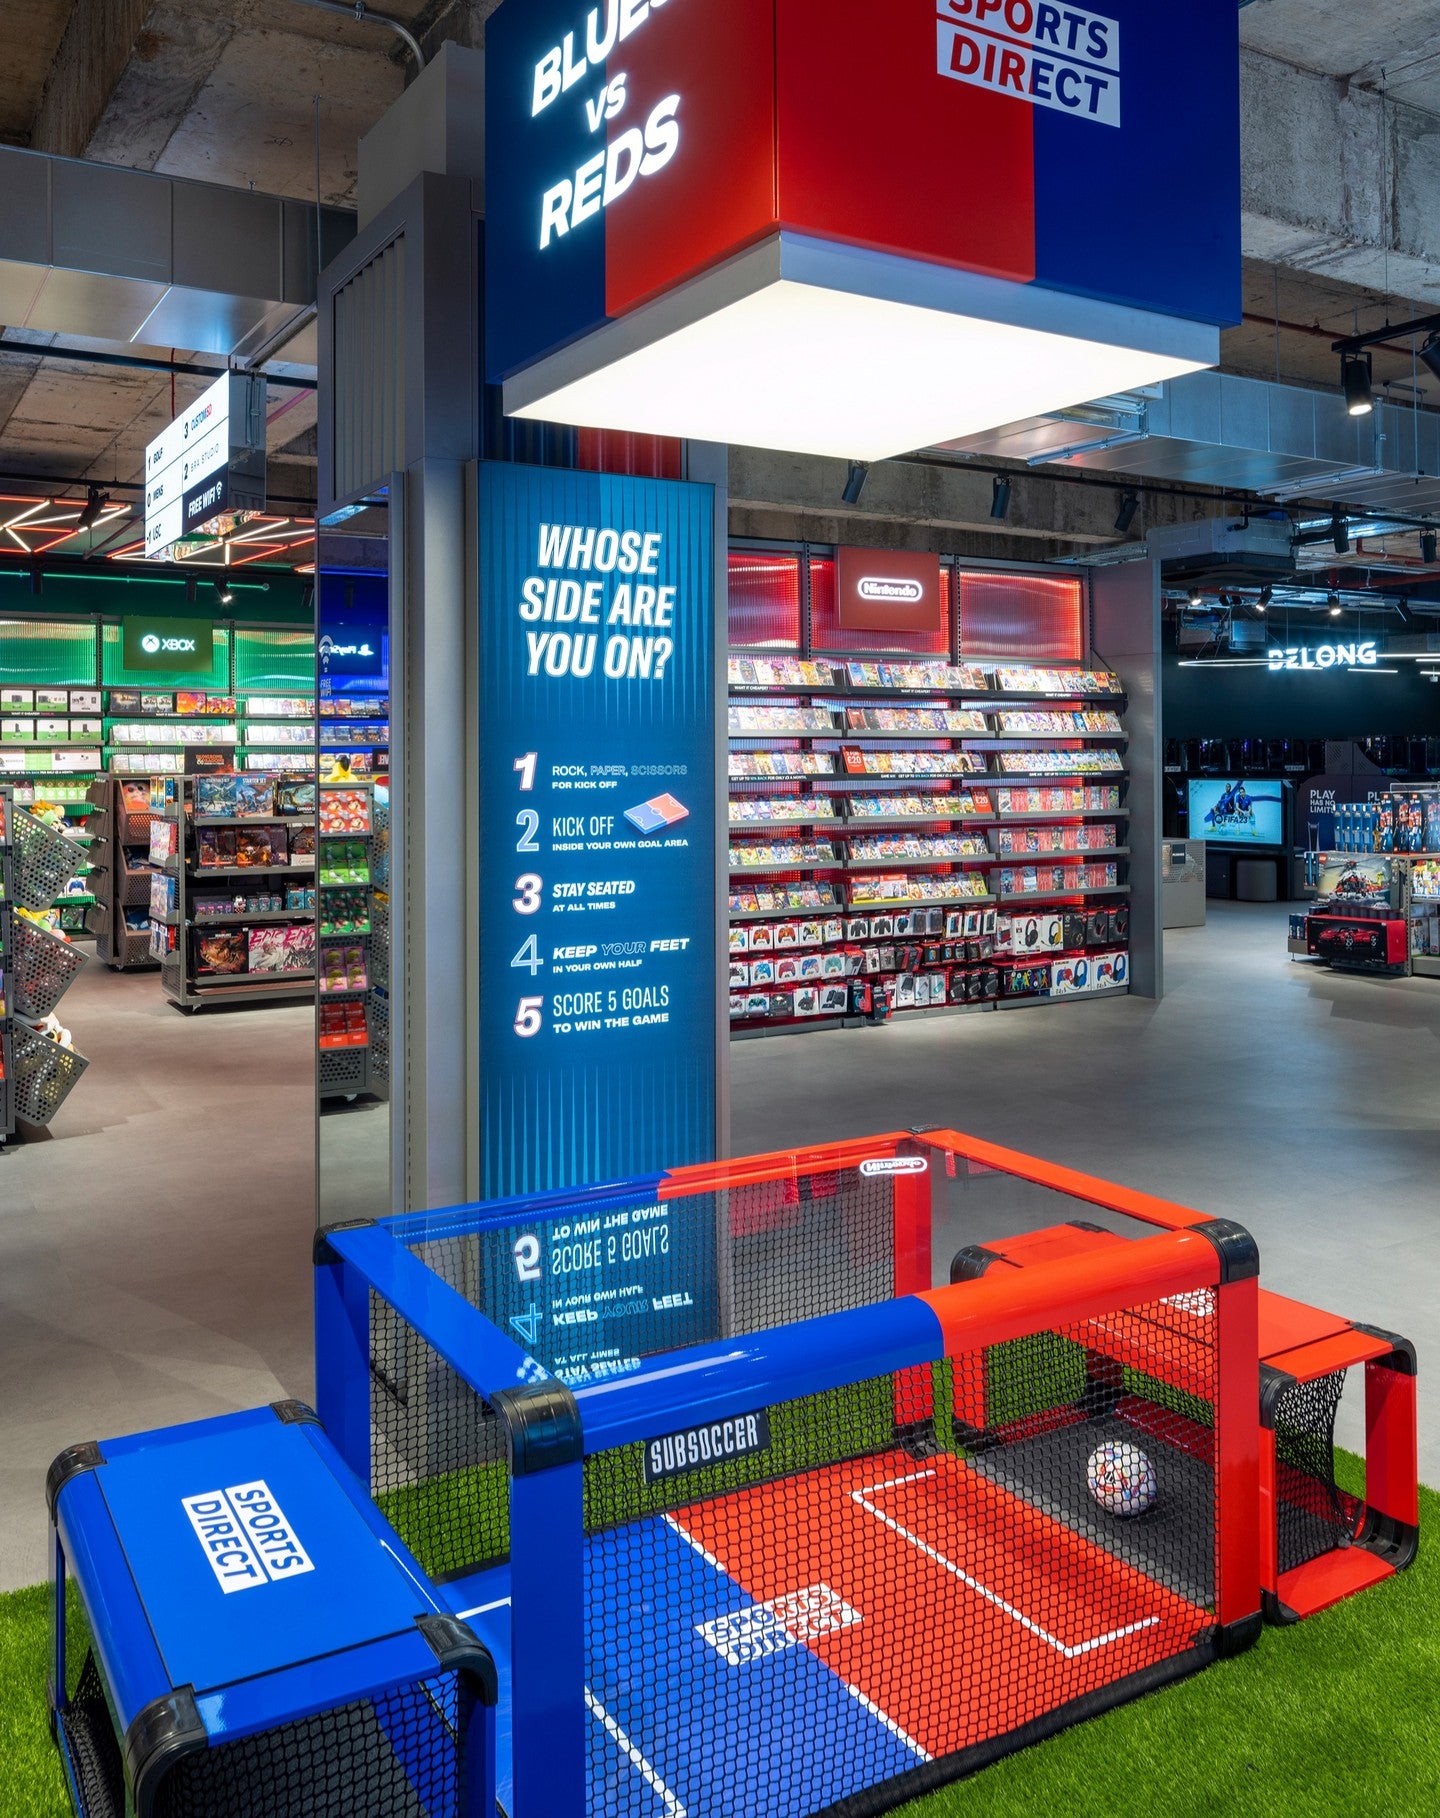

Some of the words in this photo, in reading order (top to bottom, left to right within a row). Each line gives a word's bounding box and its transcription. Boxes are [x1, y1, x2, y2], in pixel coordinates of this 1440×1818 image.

[531, 0, 669, 117] BLUE
[950, 32, 1108, 114] DIRECT
[586, 72, 627, 133] VS
[540, 94, 681, 250] REDS
[184, 422, 189, 439] 3
[153, 447, 163, 464] GOLF
[184, 463, 189, 481] 2
[202, 443, 219, 464] STUDIO
[188, 499, 202, 518] FREE
[202, 486, 216, 509] WIFI
[153, 524, 162, 541] USC
[538, 523, 662, 575] WHOSE
[519, 576, 604, 624] SIDE
[606, 583, 677, 627] ARE
[861, 581, 920, 599] Nintendo
[162, 638, 195, 651] XBOX
[526, 631, 598, 678] YOU
[603, 634, 674, 679] ON?
[1268, 642, 1377, 671] BELONG
[513, 752, 538, 791] 1
[552, 765, 587, 777] ROCK,
[590, 765, 628, 777] PAPER,
[631, 765, 687, 775] SCISSORS
[847, 755, 861, 764] £20
[975, 796, 988, 804] £20
[1310, 790, 1335, 799] PLAY
[516, 809, 539, 852] 2
[553, 816, 585, 837] KICK
[590, 816, 615, 836] OFF
[552, 843, 584, 851] INSIDE
[586, 842, 612, 850] YOUR
[613, 841, 636, 849] OWN
[638, 840, 662, 848] GOAL
[664, 839, 688, 847] AREA
[512, 873, 543, 915] 3
[552, 882, 585, 898] STAY
[587, 880, 635, 896] SEATED
[552, 904, 565, 912] AT
[567, 903, 585, 911] ALL
[587, 902, 616, 910] TIMES
[510, 934, 544, 976] 4
[553, 945, 597, 959] KEEP
[601, 941, 646, 956] YOUR
[650, 938, 690, 952] FEET
[565, 963, 591, 972] YOUR
[593, 962, 616, 970] OWN
[618, 960, 642, 968] HALF
[513, 996, 544, 1038] 5
[553, 991, 602, 1017] SCORE
[608, 990, 617, 1012] 5
[622, 985, 669, 1010] GOALS
[553, 1022, 571, 1034] TO
[575, 1020, 600, 1031] WIN
[604, 1017, 629, 1028] THE
[632, 1013, 669, 1025] GAME
[650, 1415, 759, 1474] SUBSOCCER
[190, 1500, 258, 1578] DIRECT
[234, 1489, 304, 1570] SPORTS
[711, 1590, 829, 1639] SPORTS
[731, 1608, 842, 1660] DIRECT
